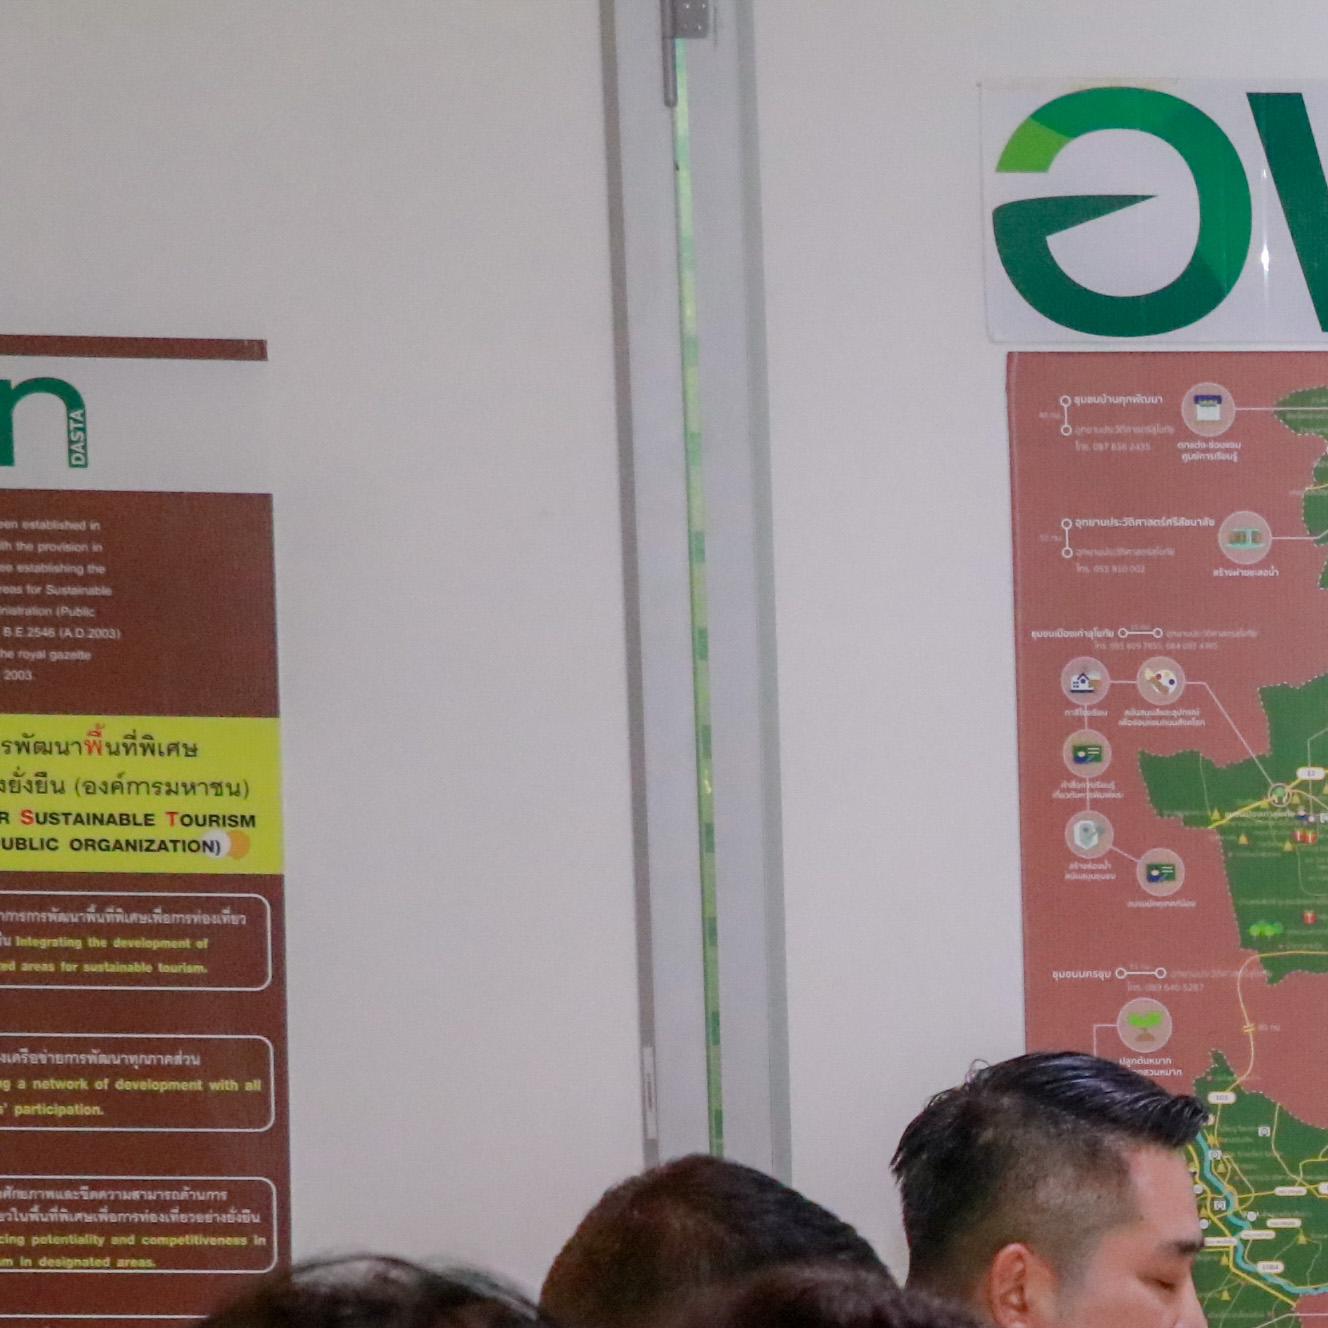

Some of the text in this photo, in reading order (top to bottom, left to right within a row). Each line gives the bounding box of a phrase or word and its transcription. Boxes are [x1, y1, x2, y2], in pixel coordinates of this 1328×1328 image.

[69, 408, 86, 467] DASTA
[74, 771, 250, 799] (องค์การมหาชน)
[20, 809, 156, 827] SUSTAINABLE
[165, 810, 257, 828] TOURISM
[1, 837, 221, 856] UBLIC ORGANIZATION)
[16, 937, 209, 950] Integrating the development of
[21, 964, 55, 972] areas
[61, 962, 78, 972] for
[83, 962, 153, 973] sustainable
[158, 963, 209, 973] tourism.
[33, 1079, 88, 1091] network
[95, 1079, 109, 1091] of
[115, 1078, 203, 1093] development
[210, 1080, 239, 1092] with
[244, 1080, 262, 1092] all
[14, 1103, 104, 1117] participation.
[31, 1233, 105, 1247] potentiality
[111, 1235, 135, 1246] and
[141, 1235, 248, 1248] competitiveness
[254, 1235, 266, 1246] in
[39, 1256, 111, 1270] designated
